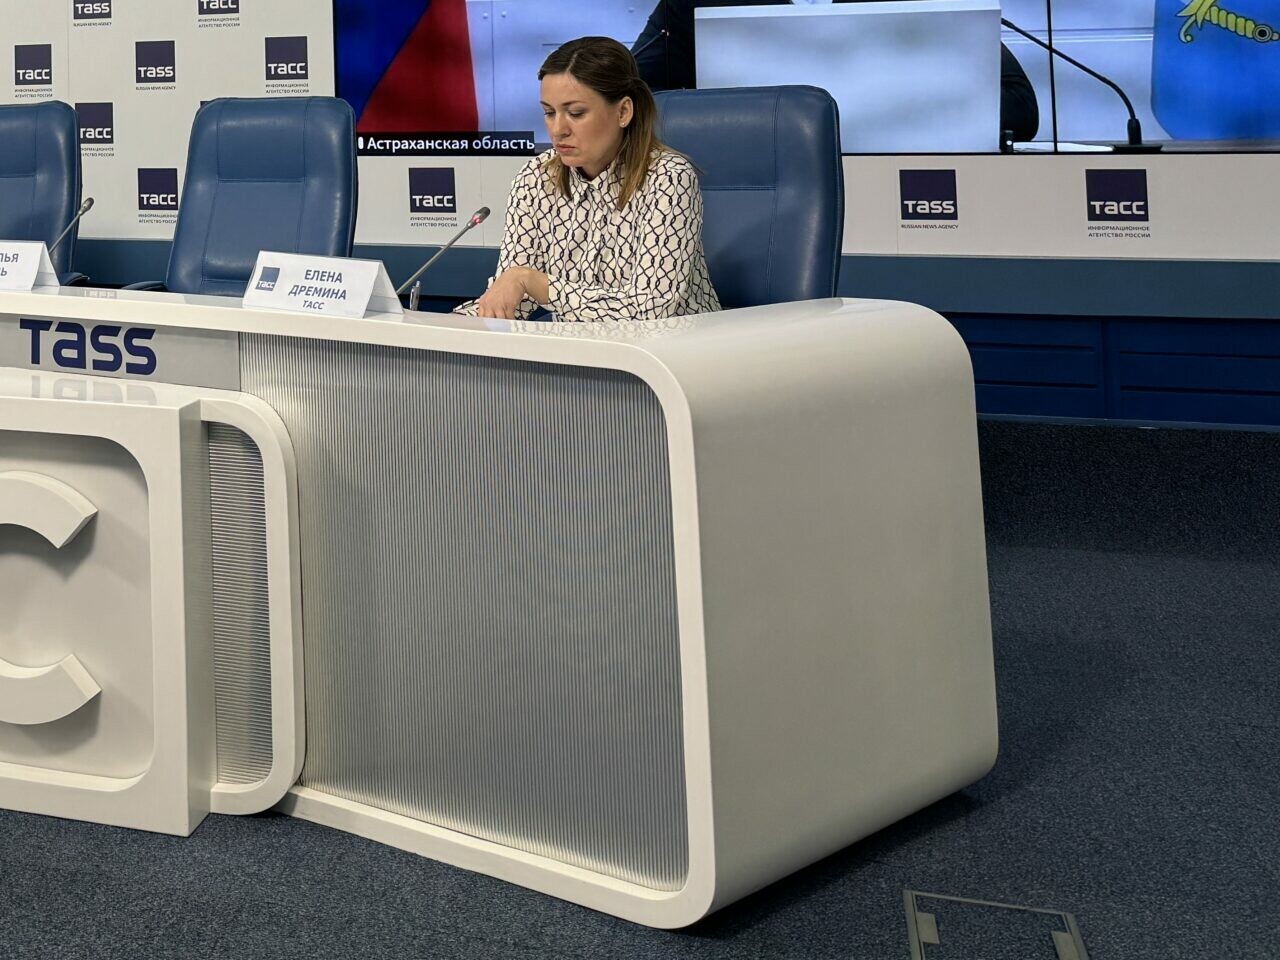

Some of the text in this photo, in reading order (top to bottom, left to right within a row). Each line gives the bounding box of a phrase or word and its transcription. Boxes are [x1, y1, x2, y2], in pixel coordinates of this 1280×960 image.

[367, 136, 535, 152] Астраханская область
[304, 269, 343, 283] ЕЛЕНА
[288, 284, 347, 300] ДРЕМИНА
[302, 300, 325, 310] ТАСС
